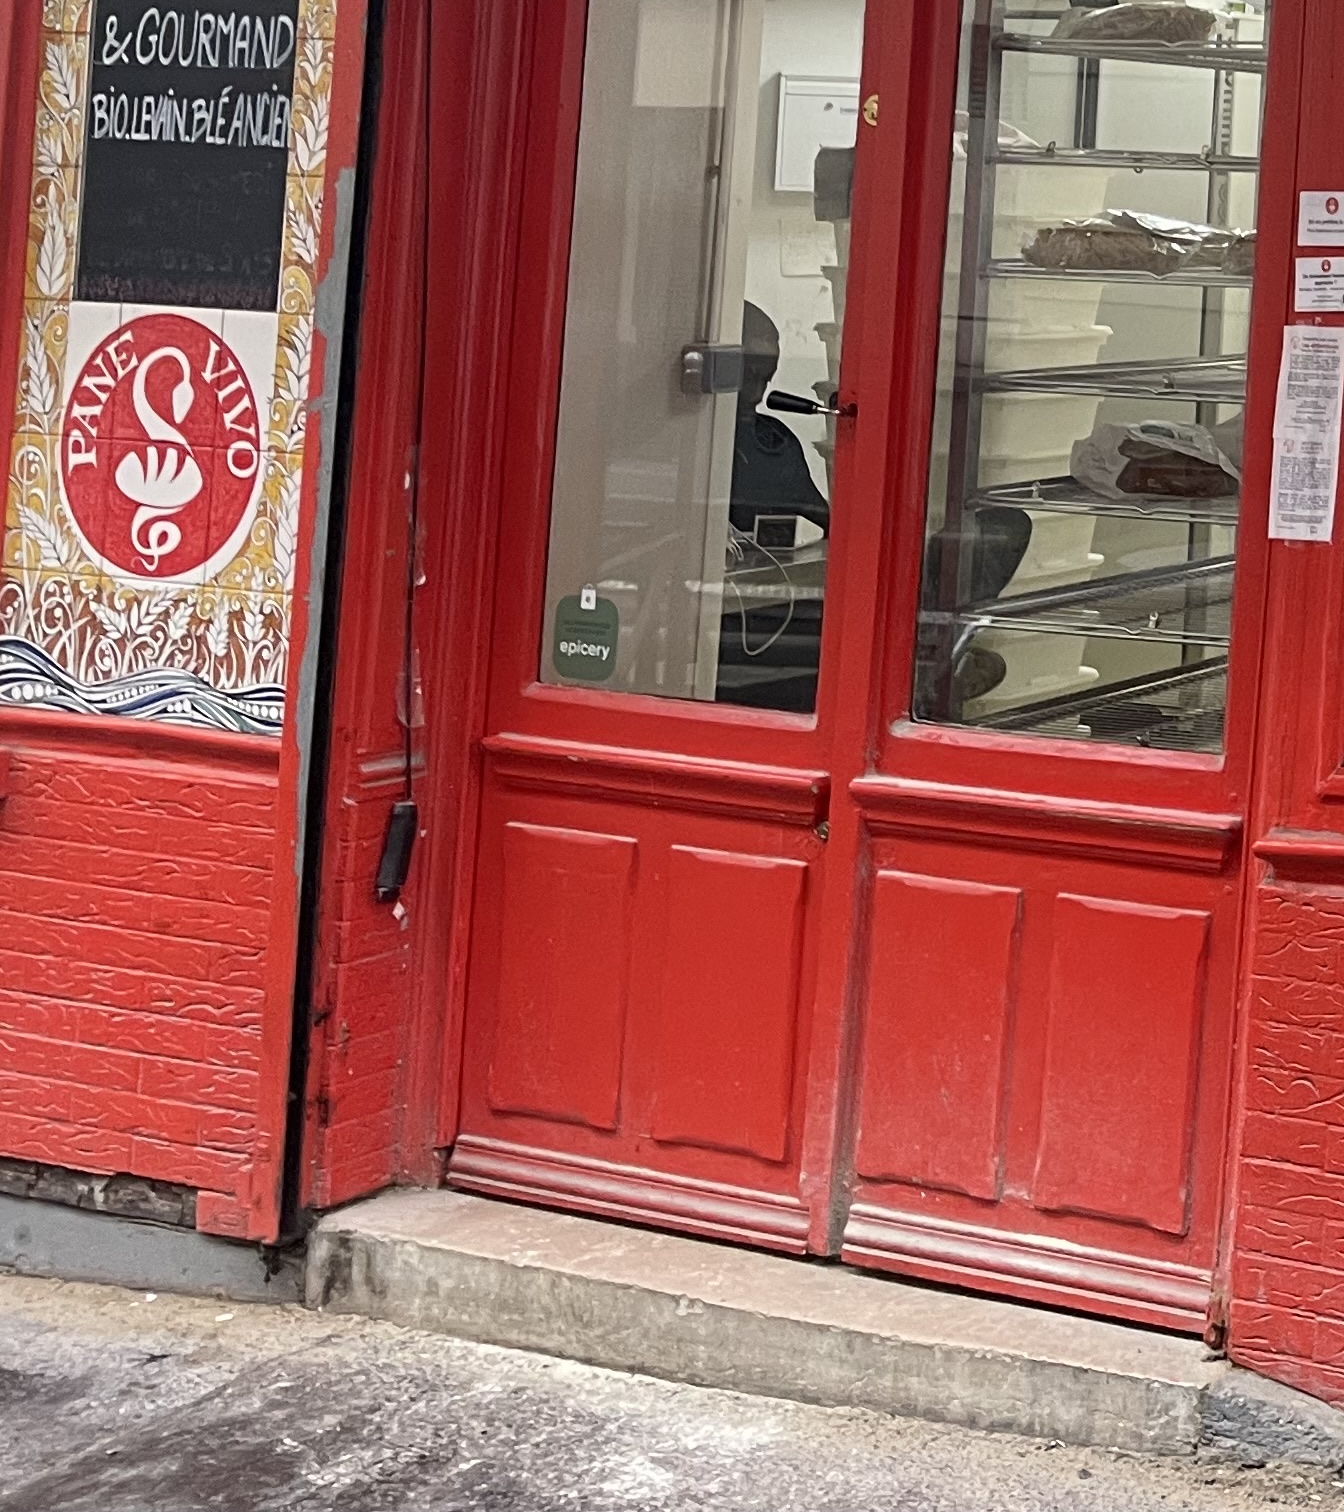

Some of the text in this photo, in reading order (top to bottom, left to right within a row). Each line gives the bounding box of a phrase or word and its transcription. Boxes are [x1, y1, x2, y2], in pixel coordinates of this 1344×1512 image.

[135, 7, 295, 69] GOURMAND
[67, 330, 262, 479] PANE VIVO
[560, 639, 610, 661] epicery
